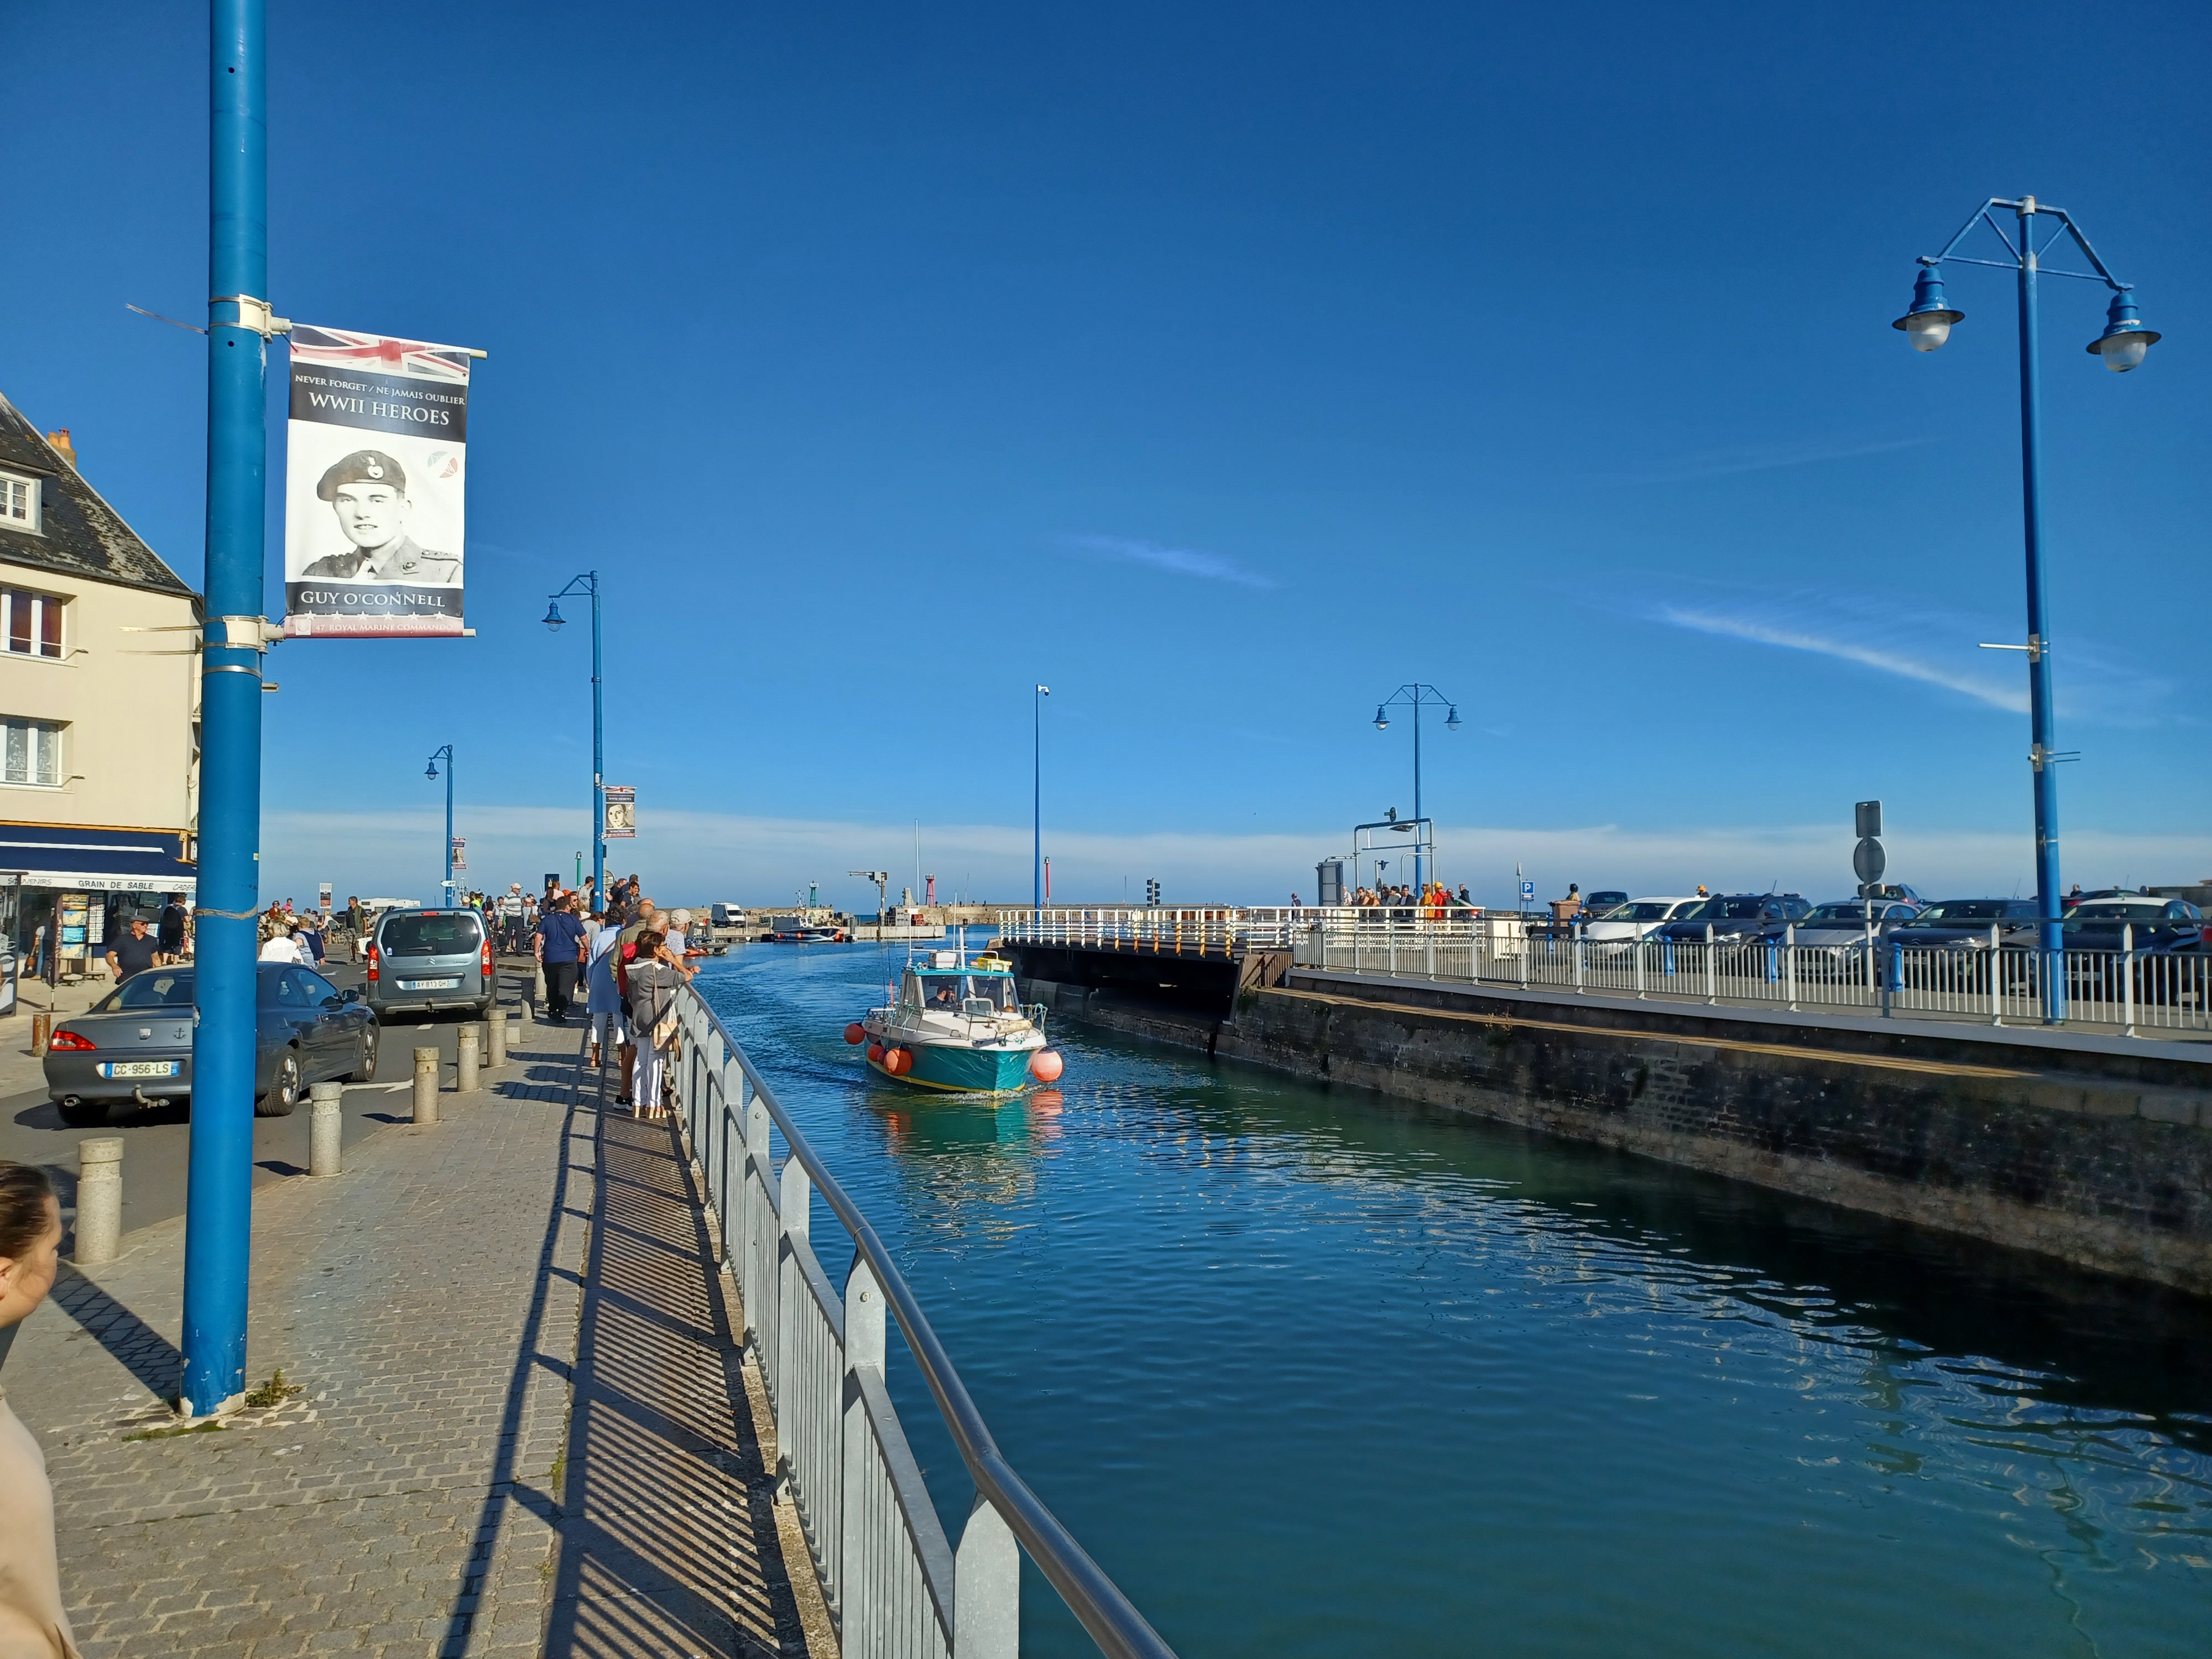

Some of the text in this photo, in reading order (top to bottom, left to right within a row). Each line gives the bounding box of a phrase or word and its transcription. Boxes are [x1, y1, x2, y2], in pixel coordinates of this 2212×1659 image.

[295, 374, 327, 386] NEVER
[329, 379, 367, 392] FORGET
[376, 387, 389, 395] NE
[391, 388, 423, 399] JAMAIS
[425, 393, 465, 405] OUBLIER
[309, 392, 449, 425] WWII HEROES
[301, 591, 445, 607] GUY O'CONNELL
[1525, 883, 1531, 892] P
[114, 1063, 169, 1075] CC-956-LS
